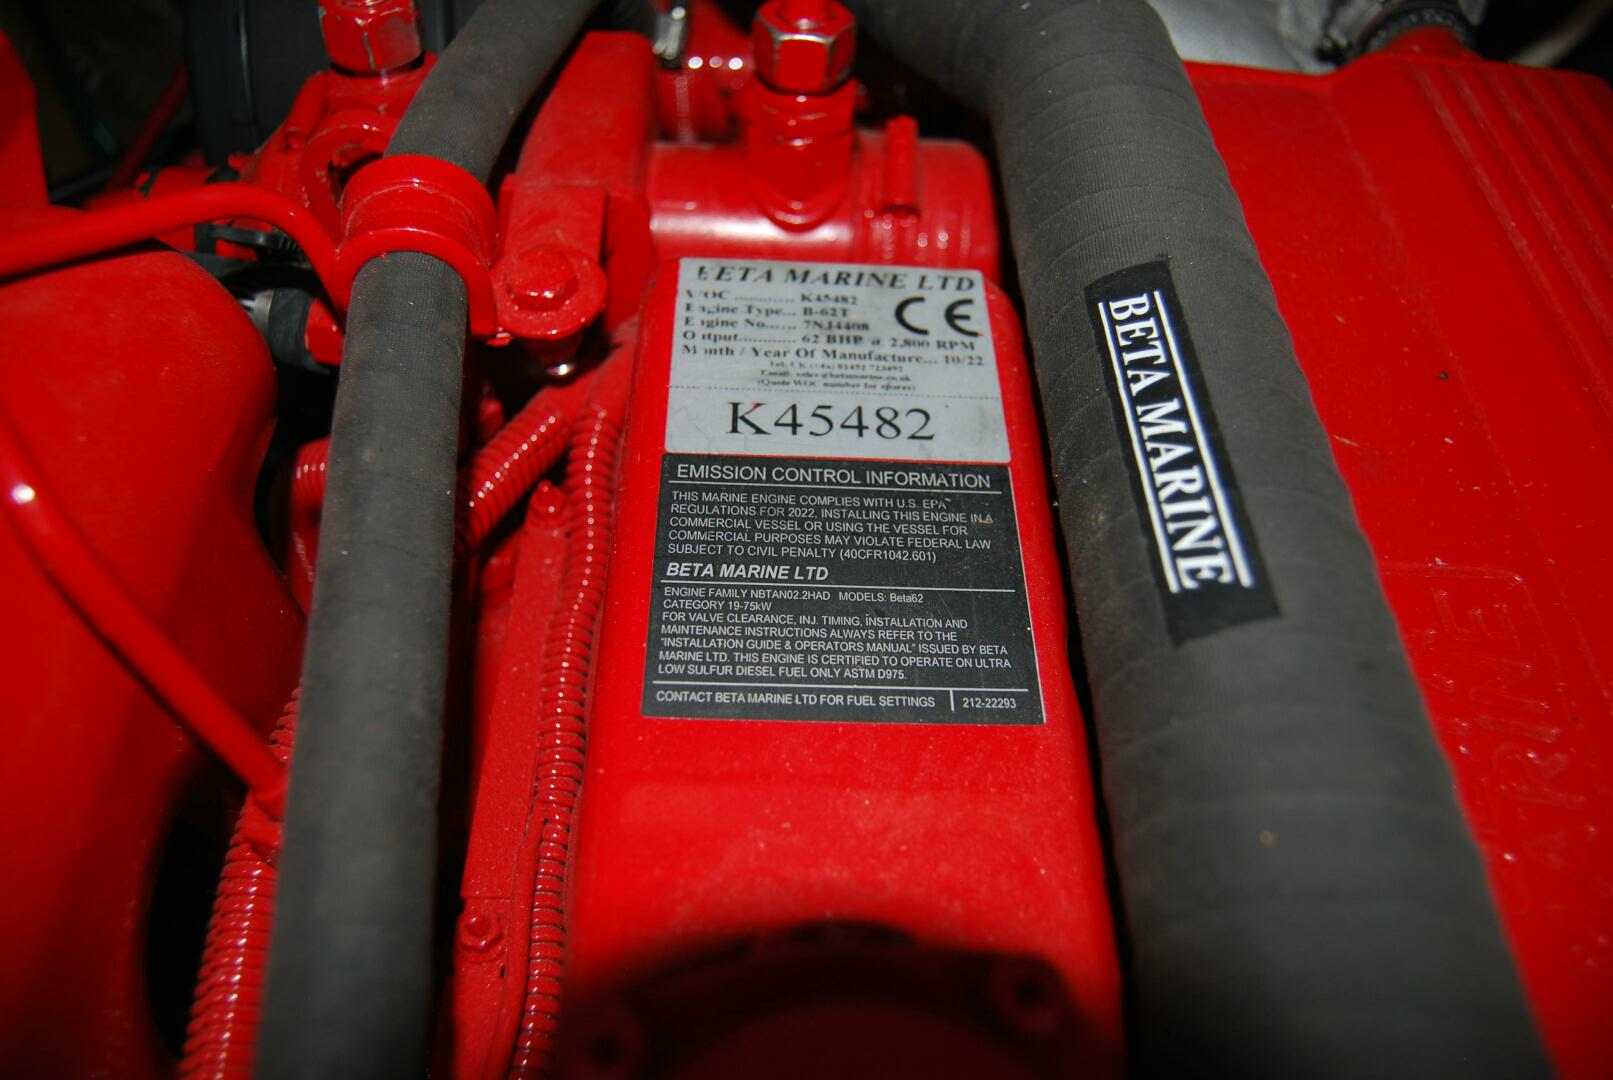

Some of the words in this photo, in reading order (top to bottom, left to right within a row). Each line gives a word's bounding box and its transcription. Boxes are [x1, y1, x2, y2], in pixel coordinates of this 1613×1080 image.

[784, 268, 908, 289] MARINE
[917, 275, 975, 291] LTD
[801, 293, 857, 305] K45482
[803, 307, 849, 317] B-62T
[894, 296, 983, 337] CE
[802, 334, 819, 344] 62
[826, 334, 863, 345] BHP
[936, 340, 976, 350] RPM
[1109, 293, 1171, 397] BETA
[752, 346, 791, 358] Year
[796, 347, 815, 358] Of
[945, 355, 984, 367] 10/22
[727, 402, 935, 441] K45482
[677, 464, 767, 481] EMISSION
[772, 467, 861, 485] CONTROL
[866, 470, 991, 489] INFORMATION
[672, 491, 699, 501] THIS
[702, 492, 748, 503] MARINE
[751, 494, 796, 505] ENGINE
[799, 496, 860, 507] COMPLIES
[863, 497, 894, 508] WITH
[897, 499, 920, 509] U.S.
[1136, 397, 1235, 590] MARINE
[671, 504, 756, 516] REGULATIONS
[760, 507, 785, 517] FOR
[788, 508, 818, 519] 2022,
[821, 508, 890, 521] INSTALLING
[894, 511, 920, 522] THIS
[923, 512, 967, 523] ENGINE
[970, 513, 982, 524] IN
[669, 517, 751, 530] COMMERCIAL
[755, 519, 801, 531] VESSEL
[804, 521, 823, 532] OR
[826, 522, 864, 533] USING
[867, 523, 890, 534] THE
[893, 524, 940, 535] VESSEL
[942, 525, 968, 536] FOR
[668, 530, 751, 543] COMMERCIAL
[754, 533, 821, 545] PURPOSES
[824, 535, 850, 546] MAY
[854, 536, 904, 548] VIOLATE
[907, 537, 962, 549] FEDERAL
[965, 539, 991, 550] LAW
[667, 544, 722, 556] SUBJECT
[725, 545, 744, 556] TO
[747, 546, 778, 557] CIVIL
[781, 547, 836, 559] PENALTY
[839, 548, 937, 564] (40CFR1042.601)
[666, 562, 715, 577] BETA
[719, 563, 790, 580] MARINE
[794, 566, 829, 581] LTD
[664, 587, 705, 597] ENGINE
[708, 588, 748, 598] FAMILY
[838, 591, 887, 602] MODELS:
[890, 593, 924, 603] Beta62
[663, 599, 724, 610] CATEGORY
[728, 601, 772, 611] 19-75kW
[662, 611, 686, 622] FOR
[688, 612, 724, 623] VALVE
[726, 613, 797, 626] CLEARANCE,
[799, 615, 819, 625] INJ.
[822, 615, 863, 627] TIMING,
[865, 616, 943, 629] INSTALLATION
[945, 619, 968, 629] AND
[661, 625, 742, 636] MAINTENANCE
[745, 626, 827, 639] INSTRUCTIONS
[829, 628, 875, 640] ALWAYS
[878, 630, 915, 640] REFER
[917, 631, 933, 641] TO
[935, 631, 957, 642] THE
[746, 639, 782, 650] GUIDE
[784, 640, 792, 650] &
[795, 641, 864, 652] OPERATORS
[918, 643, 959, 654] ISSUED
[962, 645, 976, 654] BY
[979, 645, 1008, 655] BETA
[659, 650, 703, 662] MARINE
[705, 652, 730, 662] LTD.
[733, 652, 759, 663] THIS
[762, 653, 805, 664] ENGINE
[807, 654, 819, 664] IS
[821, 654, 880, 666] CERTIFIED
[883, 656, 898, 666] TO
[900, 656, 953, 667] OPERATE
[955, 657, 973, 668] ON
[975, 657, 1012, 669] ULTRA
[658, 664, 685, 674] LOW
[687, 664, 733, 676] SULFUR
[735, 665, 776, 677] DIESEL
[778, 666, 807, 677] FUEL
[809, 667, 841, 678] ONLY
[843, 668, 875, 679] ASTM
[656, 691, 712, 702] CONTACT
[715, 692, 746, 703] BETA
[748, 692, 792, 704] MARINE
[795, 693, 817, 705] LTD
[819, 694, 844, 705] FOR
[847, 695, 876, 706] FUEL
[879, 696, 935, 707] SETTINGS
[962, 697, 1017, 709] 212-22293
